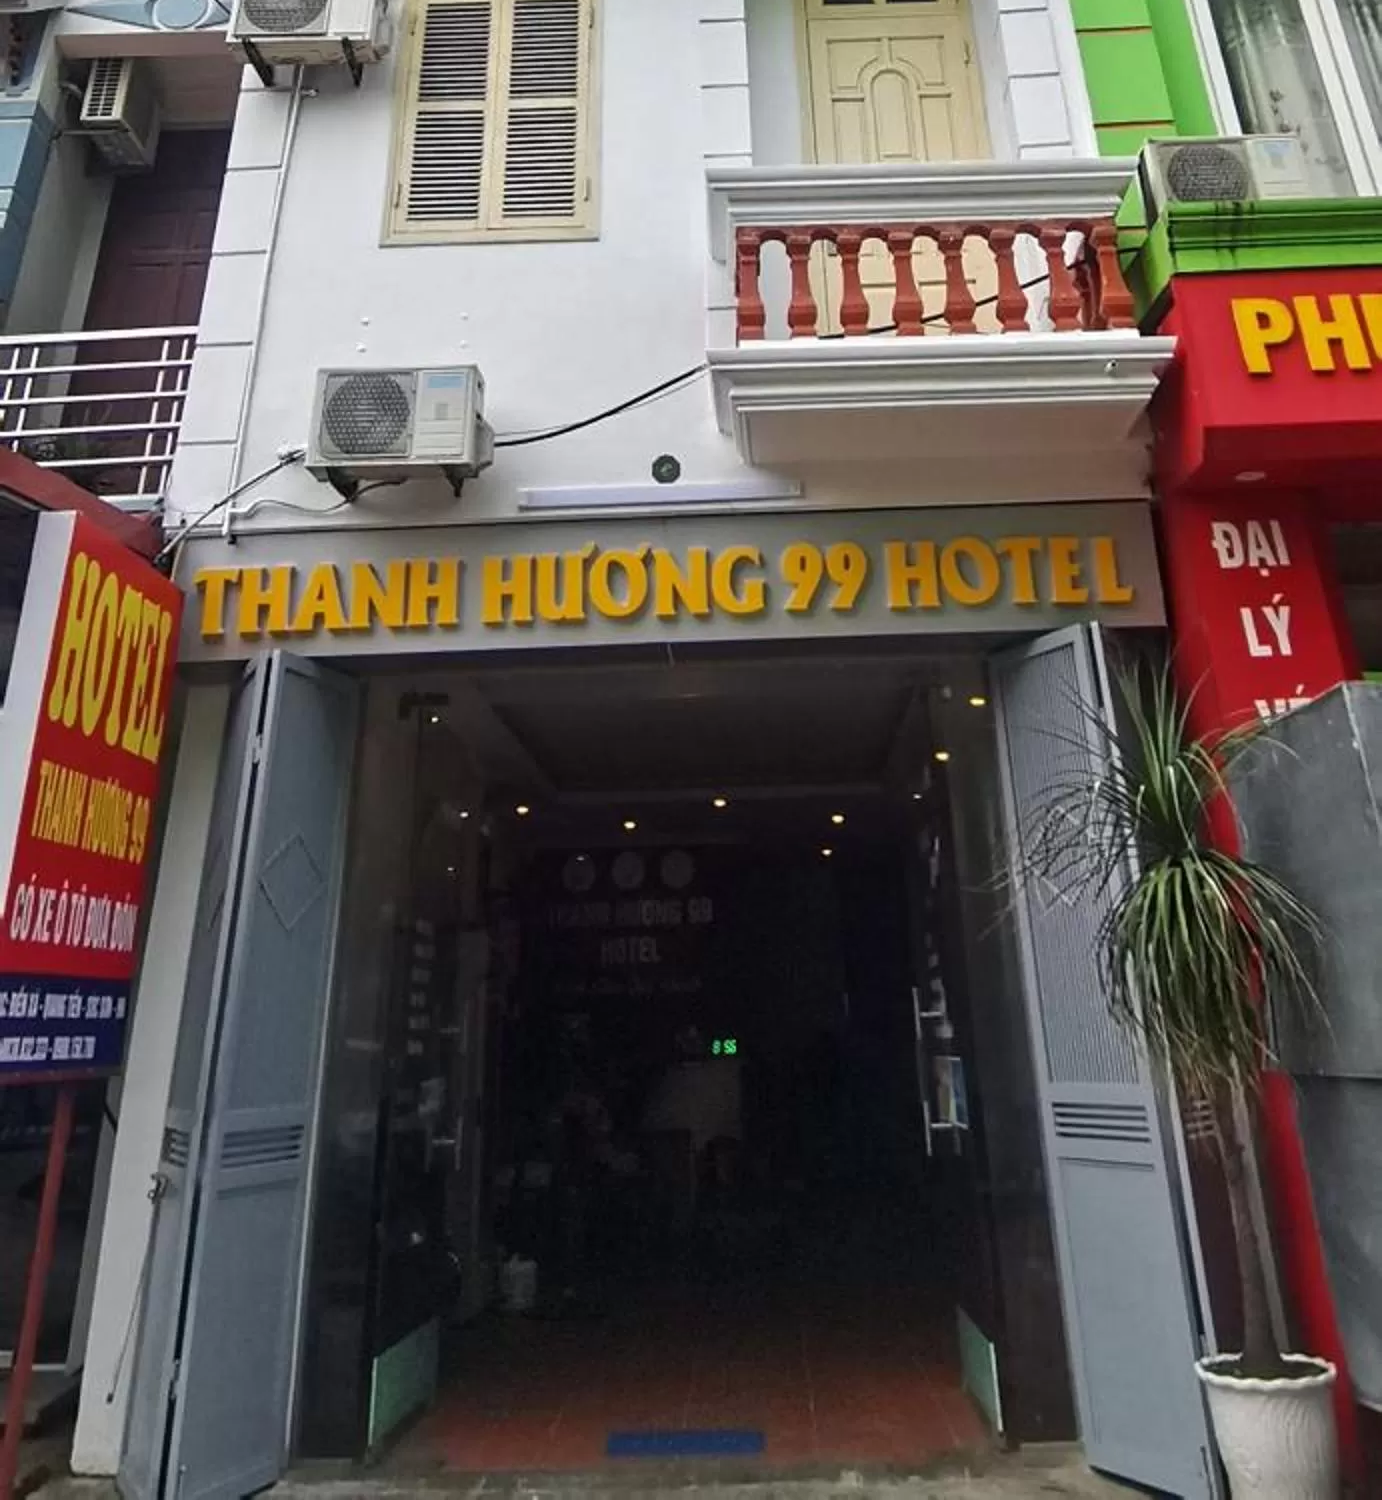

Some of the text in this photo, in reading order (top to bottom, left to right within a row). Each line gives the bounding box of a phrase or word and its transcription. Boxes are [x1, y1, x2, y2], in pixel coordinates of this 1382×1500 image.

[195, 536, 1134, 636] THANH HƯƠNG 99 HOTEL
[1211, 519, 1291, 577] ĐẠI
[48, 551, 173, 764] HOTEL
[1239, 593, 1293, 658] LÝ
[31, 759, 88, 848] THANH
[128, 795, 151, 865] 99
[10, 873, 37, 941] CÓ
[31, 887, 57, 944] XE
[53, 878, 69, 946] Ô
[65, 883, 88, 948] TÔ
